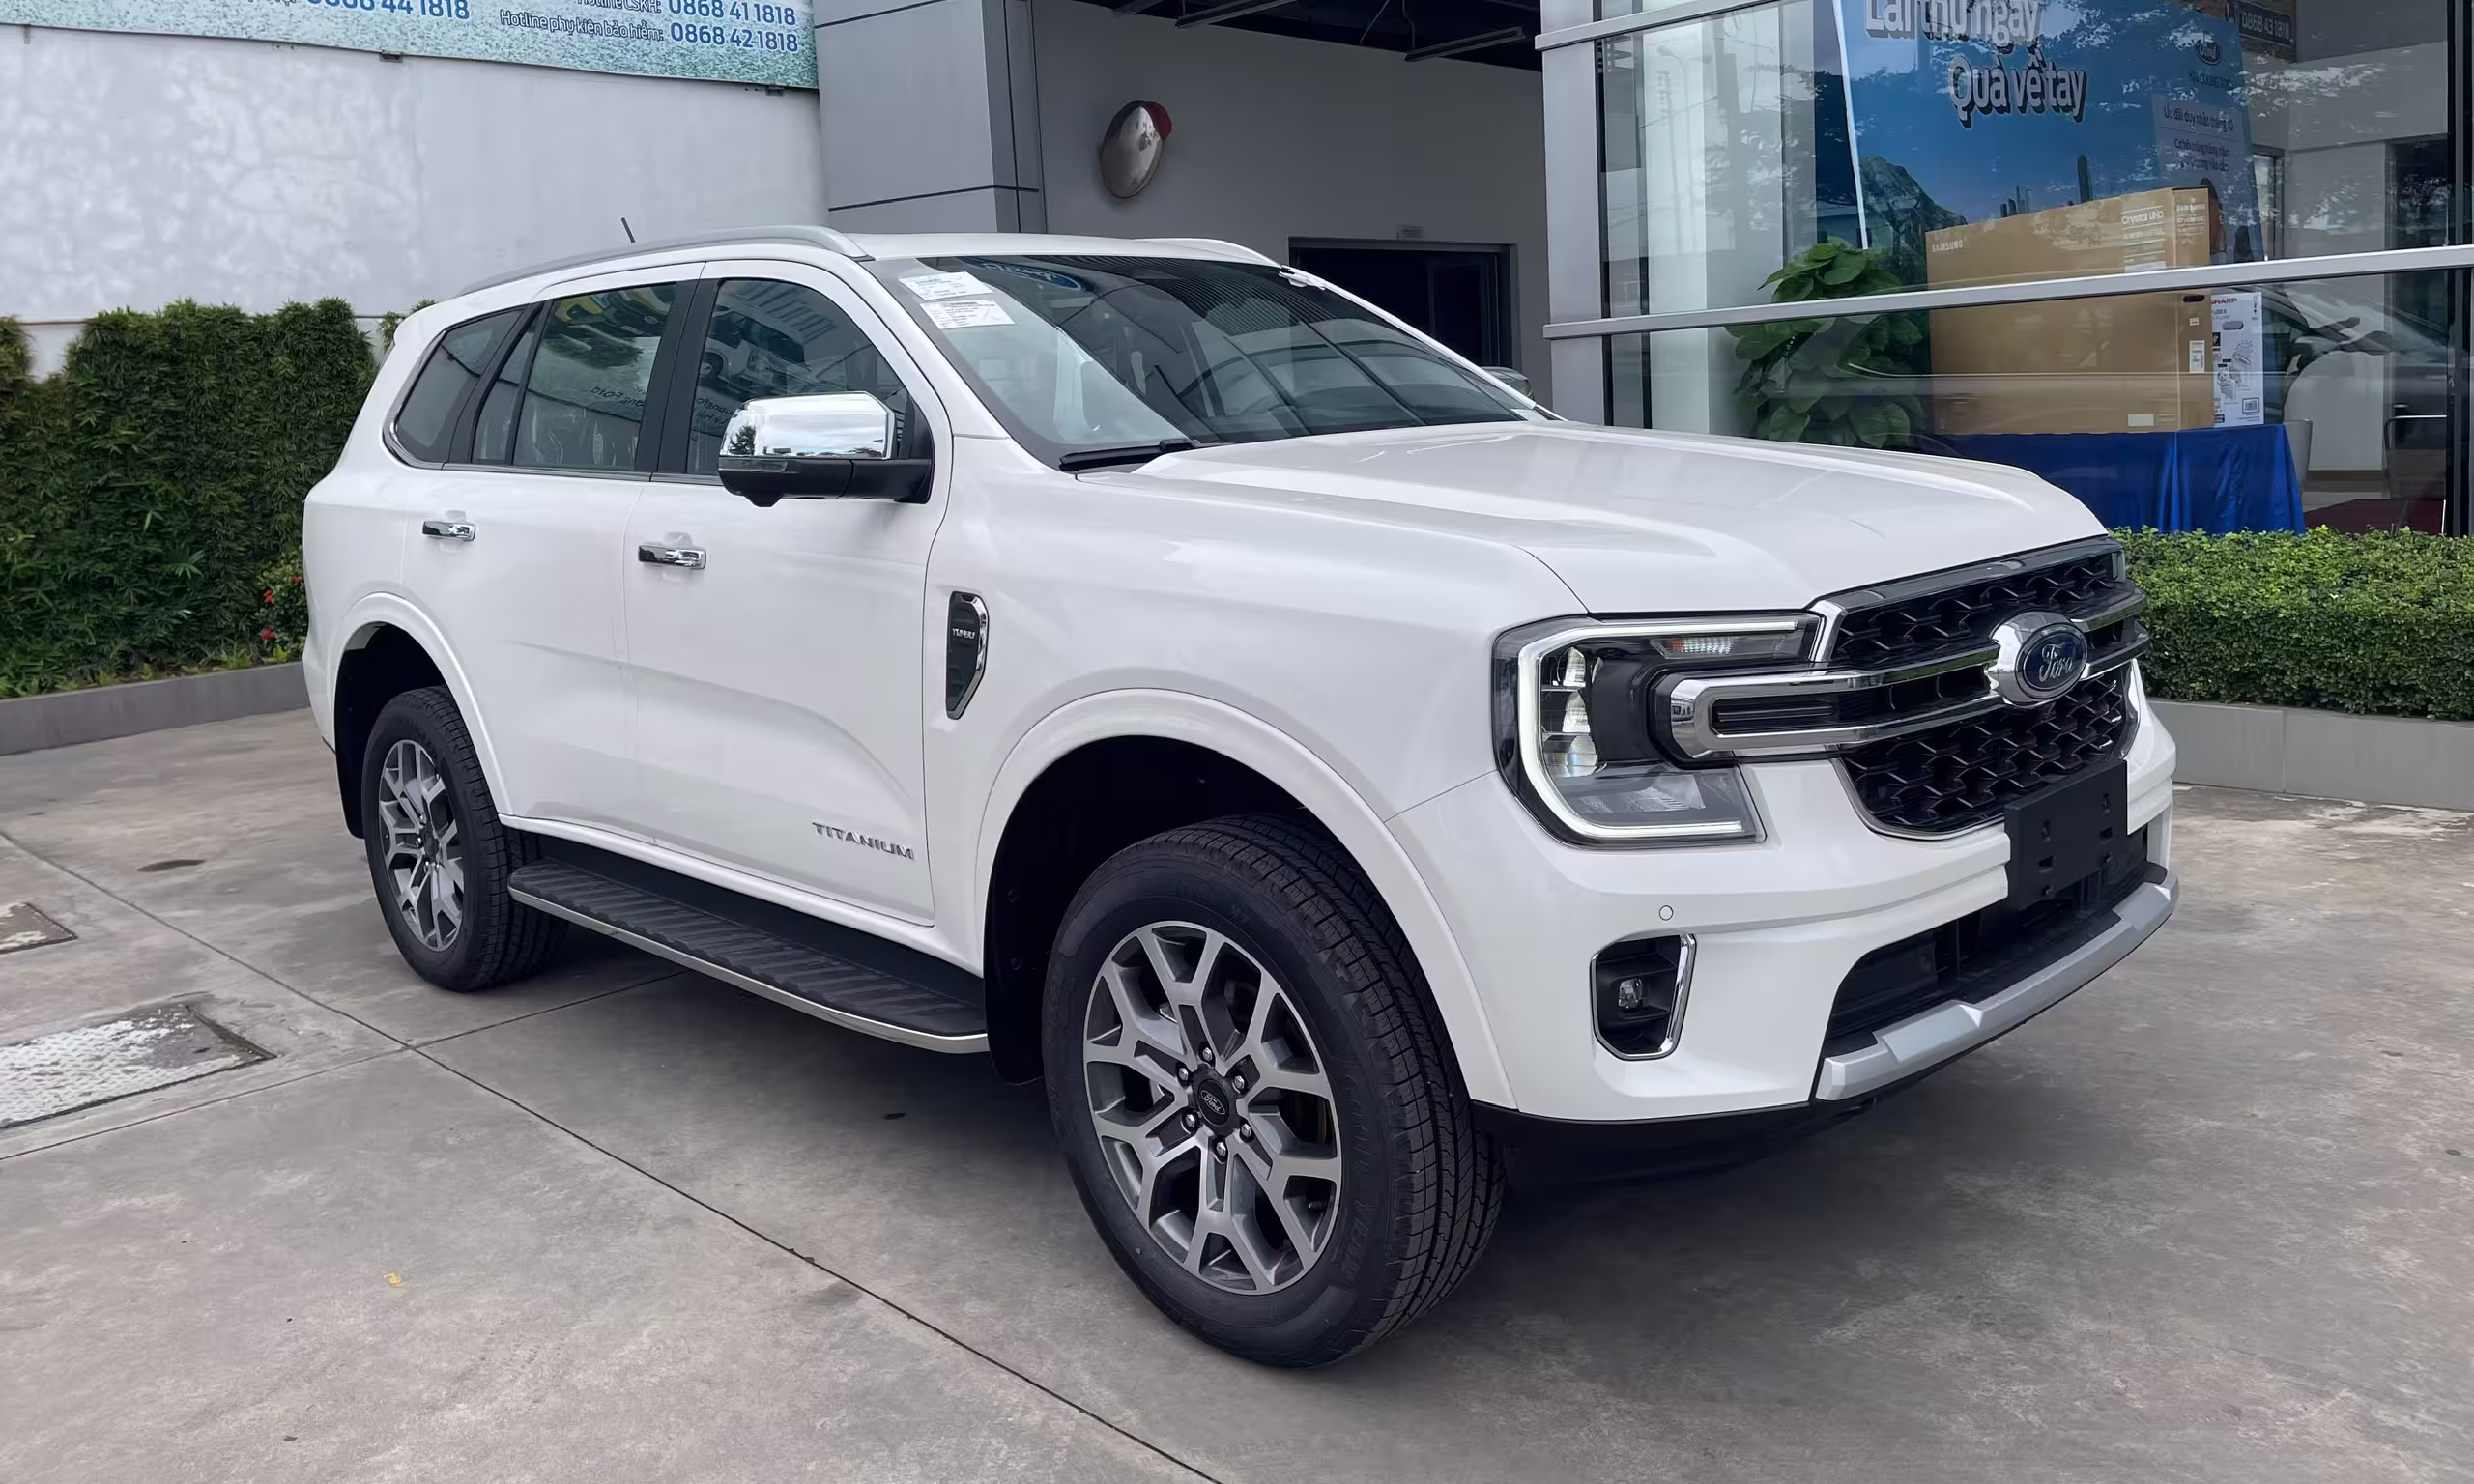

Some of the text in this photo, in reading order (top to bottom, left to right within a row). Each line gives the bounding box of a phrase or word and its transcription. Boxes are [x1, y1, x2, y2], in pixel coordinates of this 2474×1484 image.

[420, 0, 470, 19] 1818
[669, 0, 724, 18] 0868
[729, 1, 750, 21] 41
[755, 4, 796, 26] 1818
[500, 10, 549, 30] Hotline
[549, 16, 574, 36] phụ
[576, 15, 602, 37] kiện
[603, 18, 628, 38] bảo
[671, 23, 725, 45] 0868
[729, 28, 754, 48] 42
[757, 31, 798, 53] 1818
[2241, 11, 2263, 32] 0868
[2274, 19, 2290, 40] 1818
[1948, 54, 2010, 125] Quà
[2044, 61, 2087, 123] tay
[2121, 214, 2148, 225] Crystal
[1932, 240, 1964, 252] SAMSUNG
[2038, 642, 2074, 683] Ford
[812, 821, 914, 860] TITANIUM
[1203, 1094, 1222, 1113] Ford
